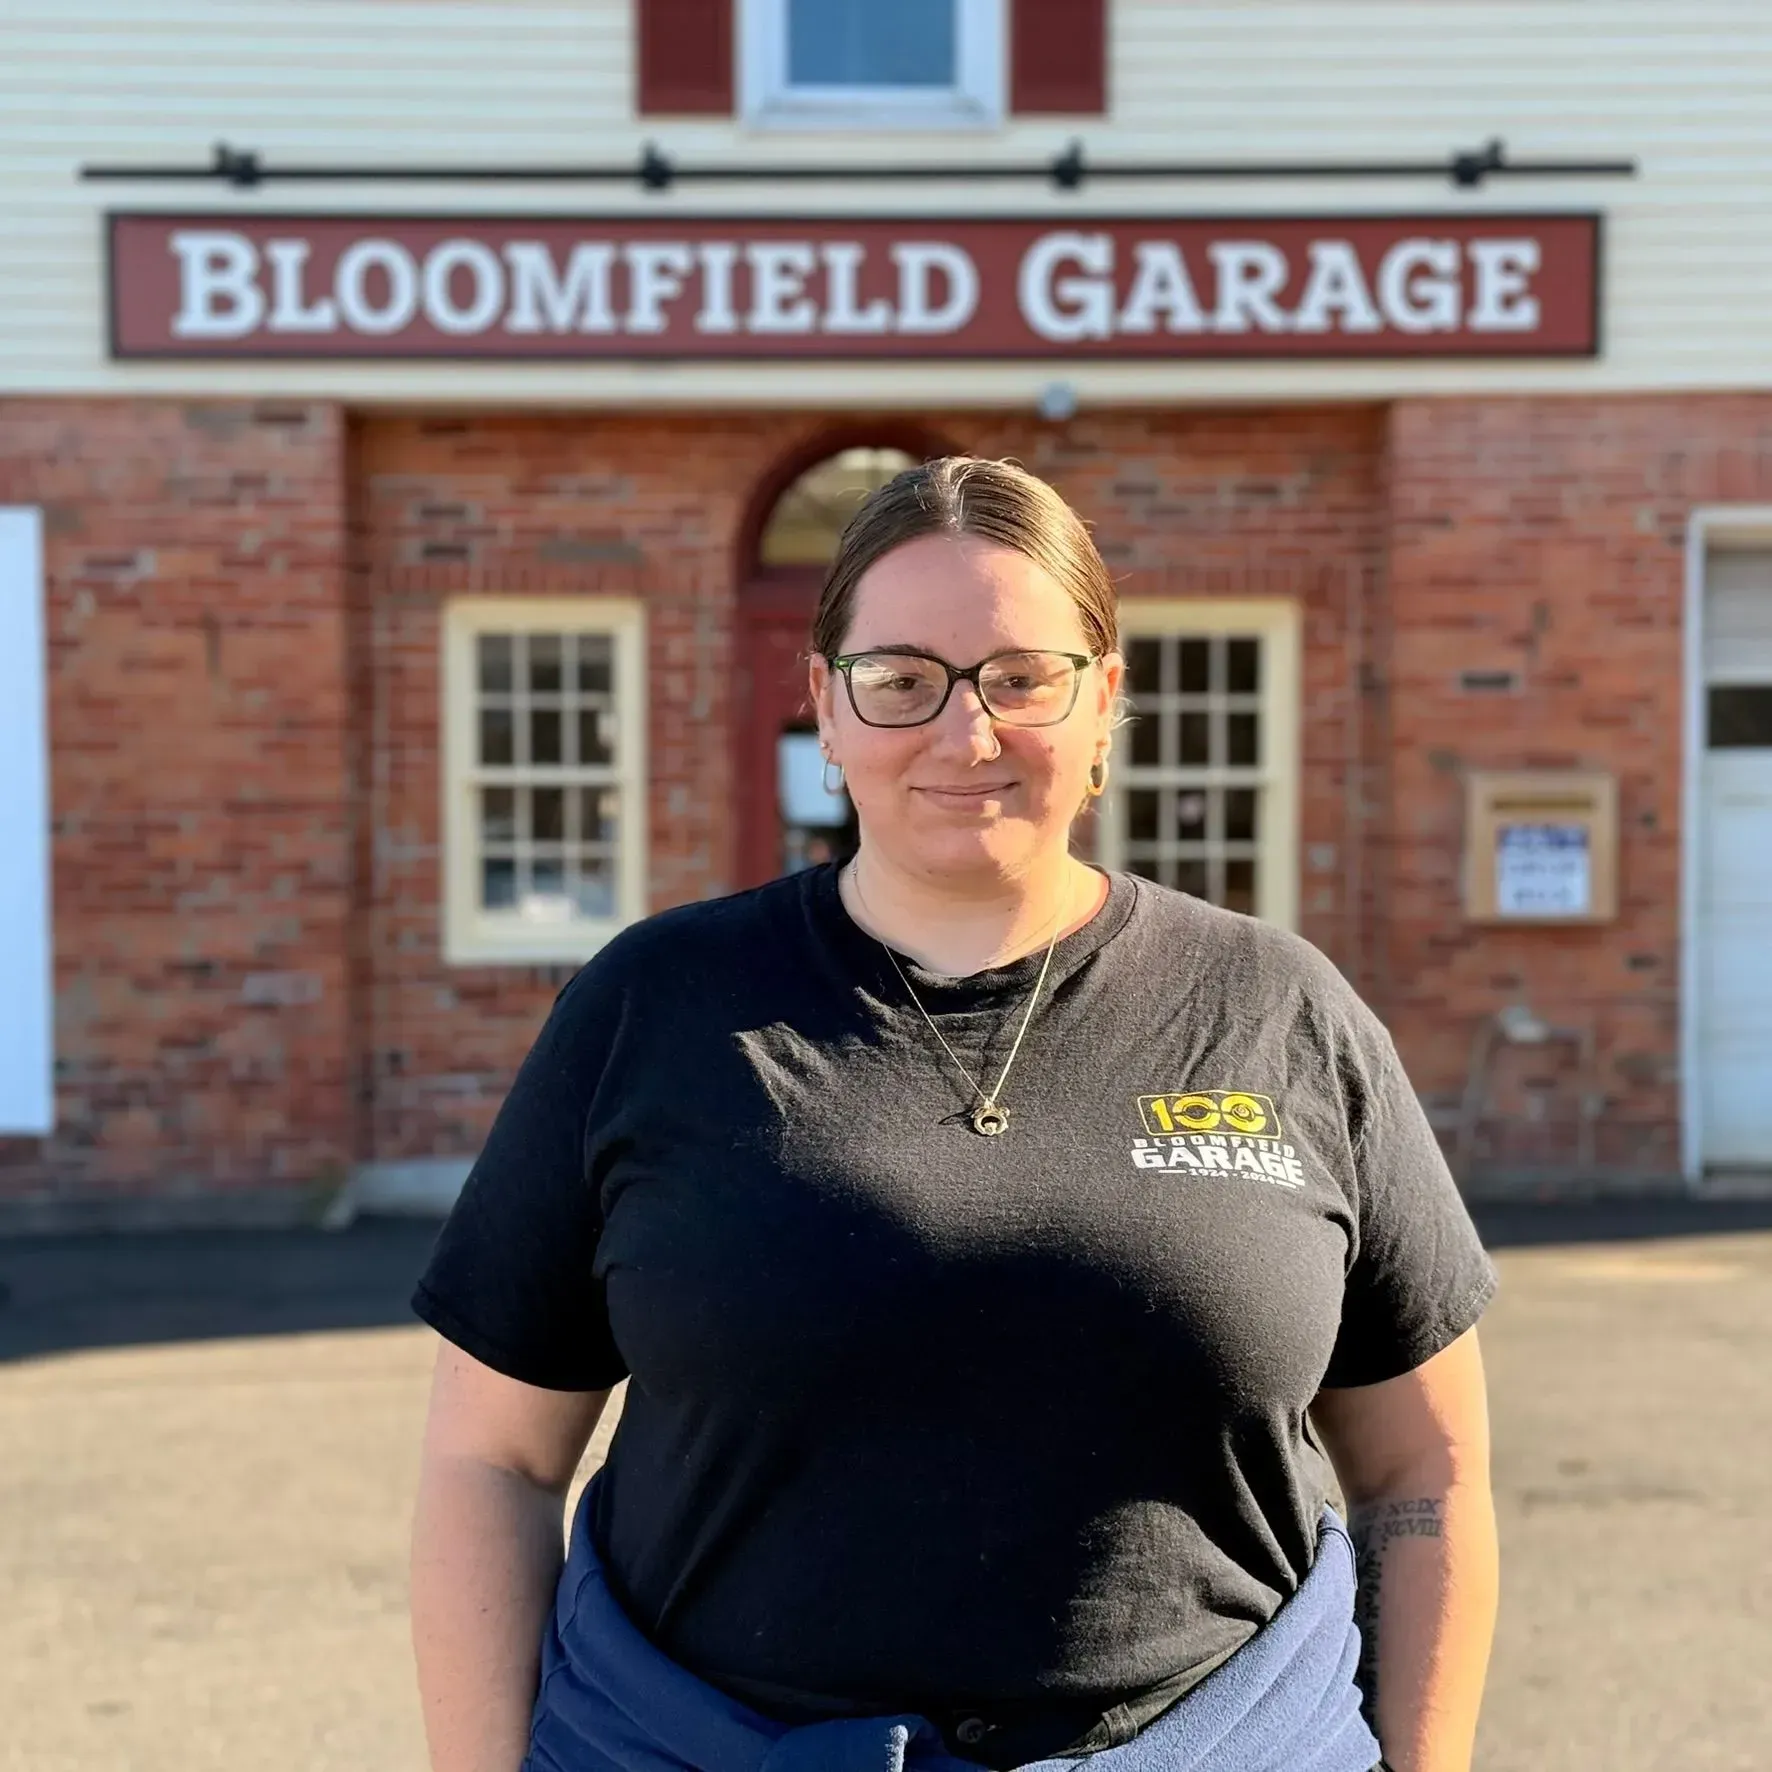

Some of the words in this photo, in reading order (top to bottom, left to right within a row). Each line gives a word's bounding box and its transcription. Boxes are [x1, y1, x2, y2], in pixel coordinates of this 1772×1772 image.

[169, 229, 979, 337] BLOOMFIELD
[1018, 231, 1541, 341] GARAGE
[1150, 1094, 1267, 1133] 100
[1130, 1146, 1306, 1187] GARAGE
[1132, 1135, 1296, 1159] BLOOMFIELD
